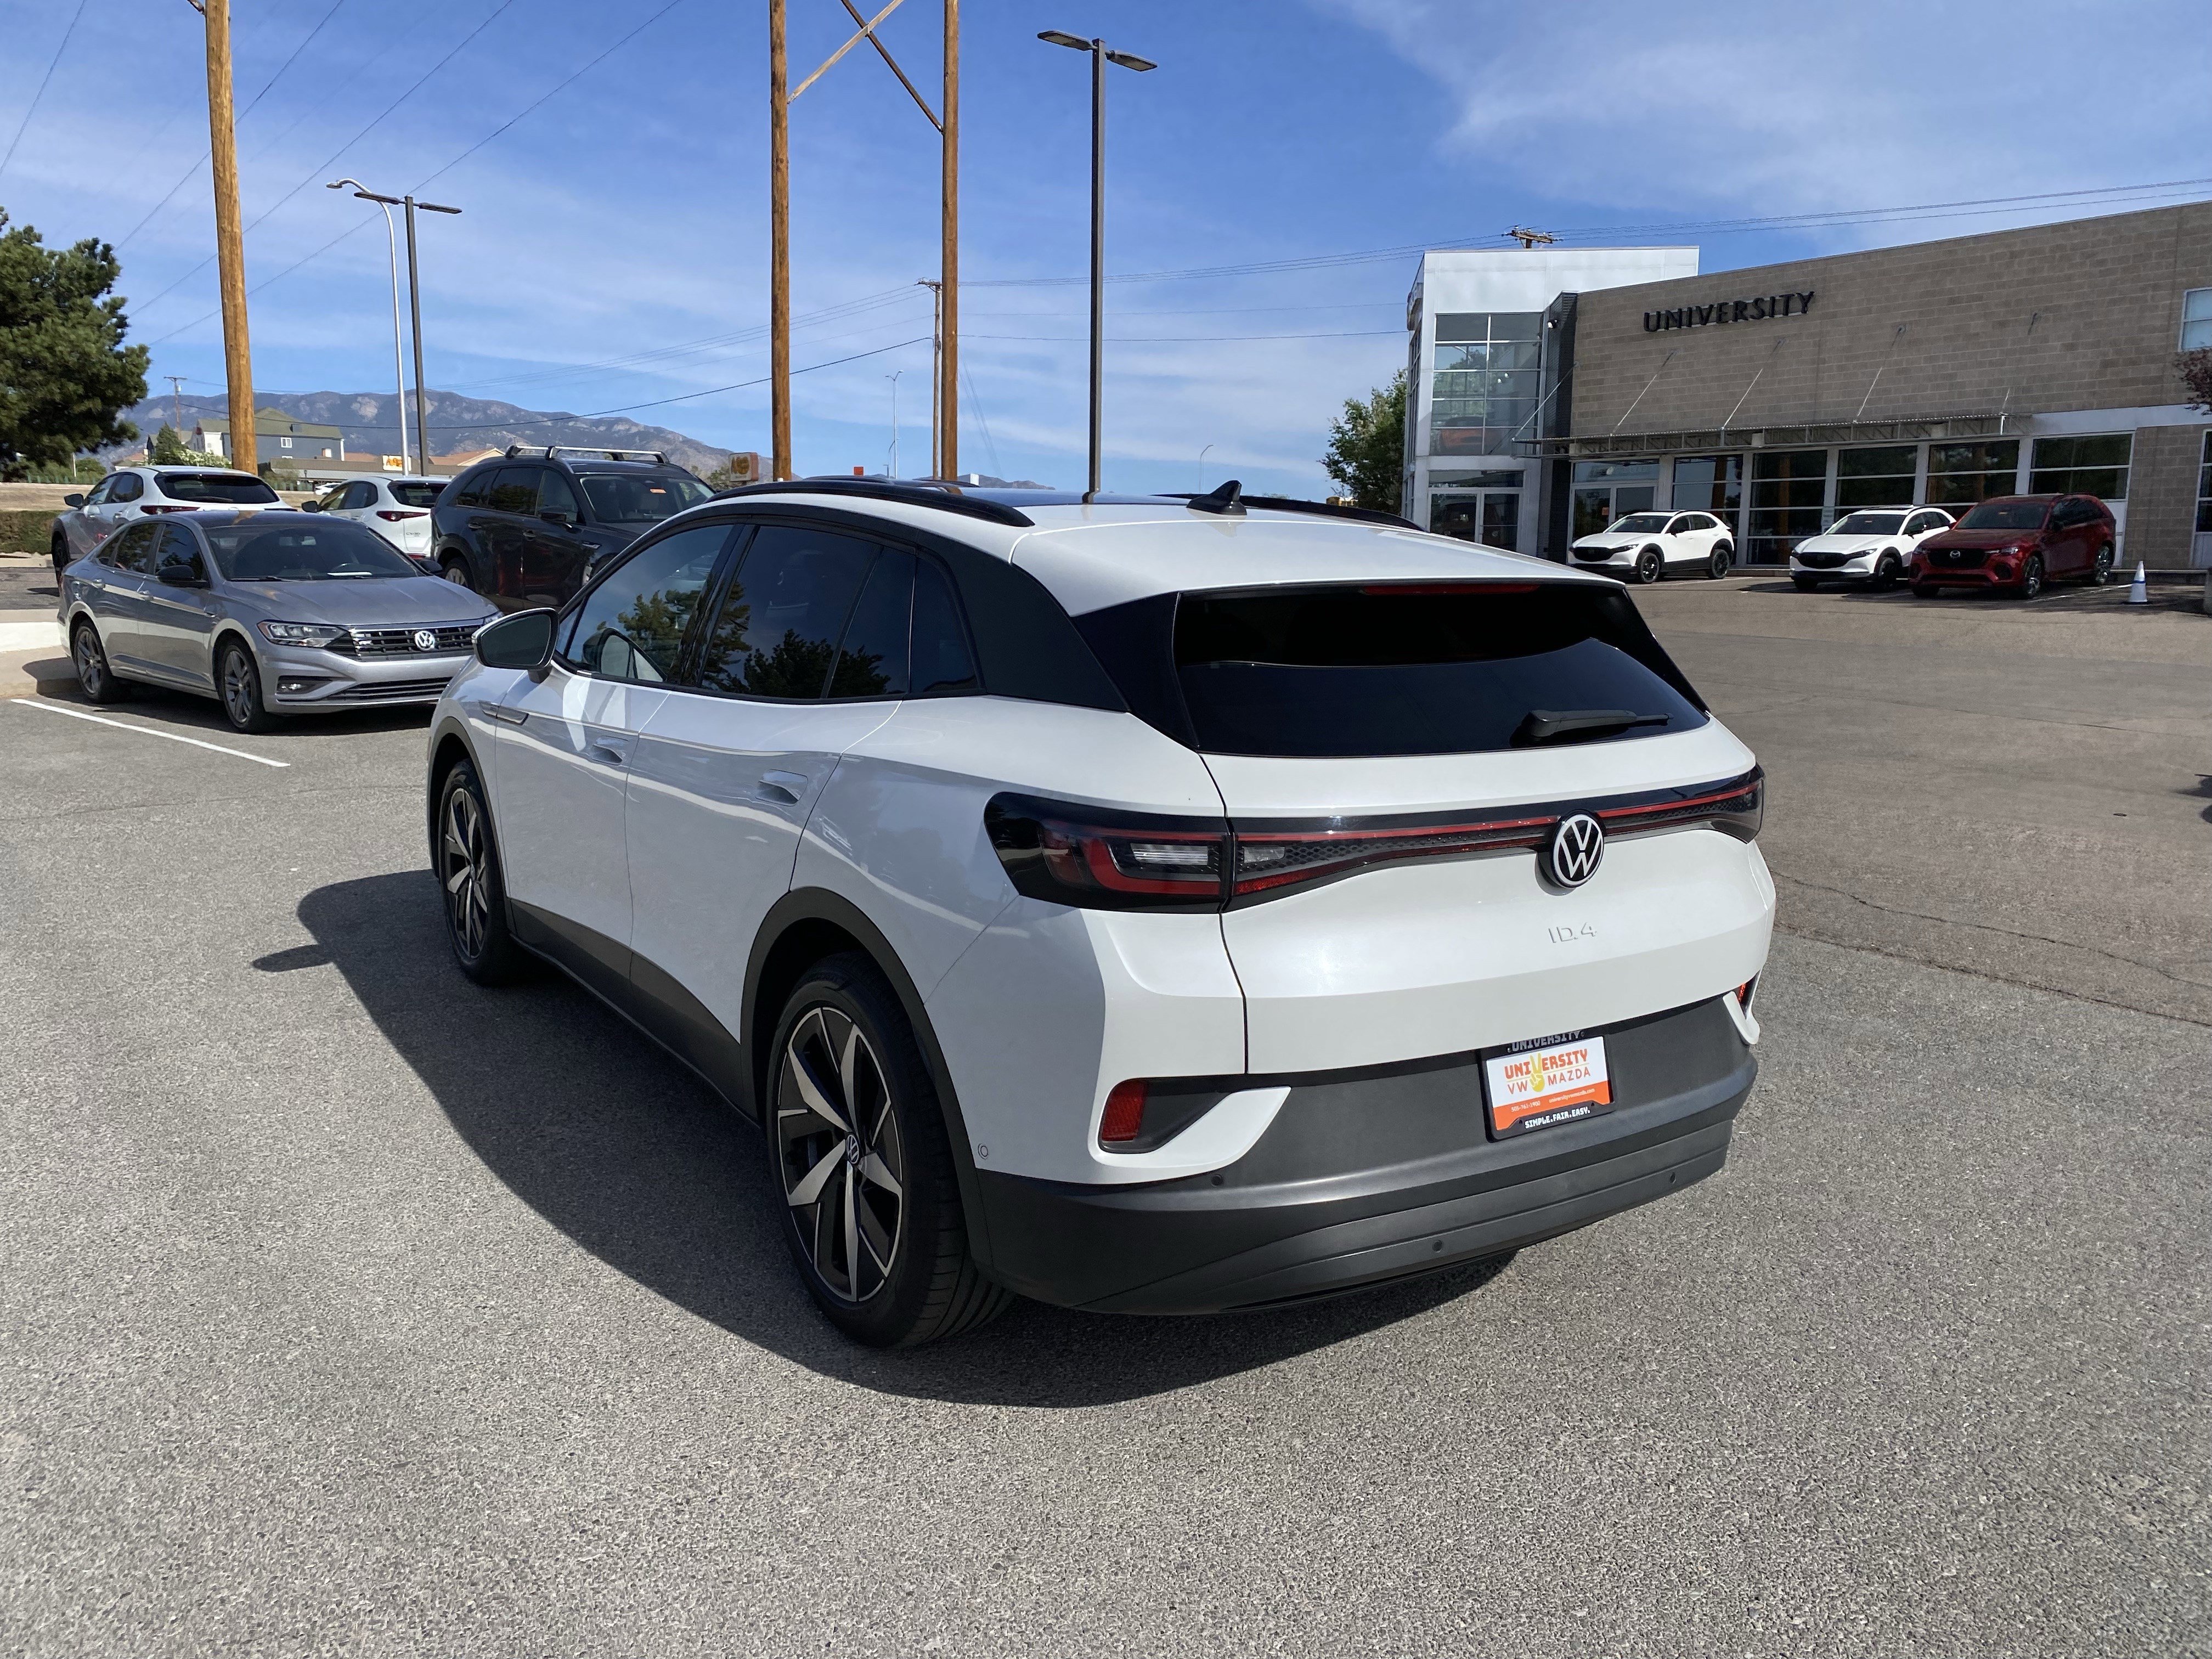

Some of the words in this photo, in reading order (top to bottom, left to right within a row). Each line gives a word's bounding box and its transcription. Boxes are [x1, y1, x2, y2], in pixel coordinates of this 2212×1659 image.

[1644, 291, 1815, 332] UNIVERSITY
[1548, 922, 1596, 943] ID.4
[1512, 1030, 1581, 1052] UNIVERSITY
[1508, 1080, 1528, 1094] VW
[1548, 1067, 1591, 1086] MAZDA
